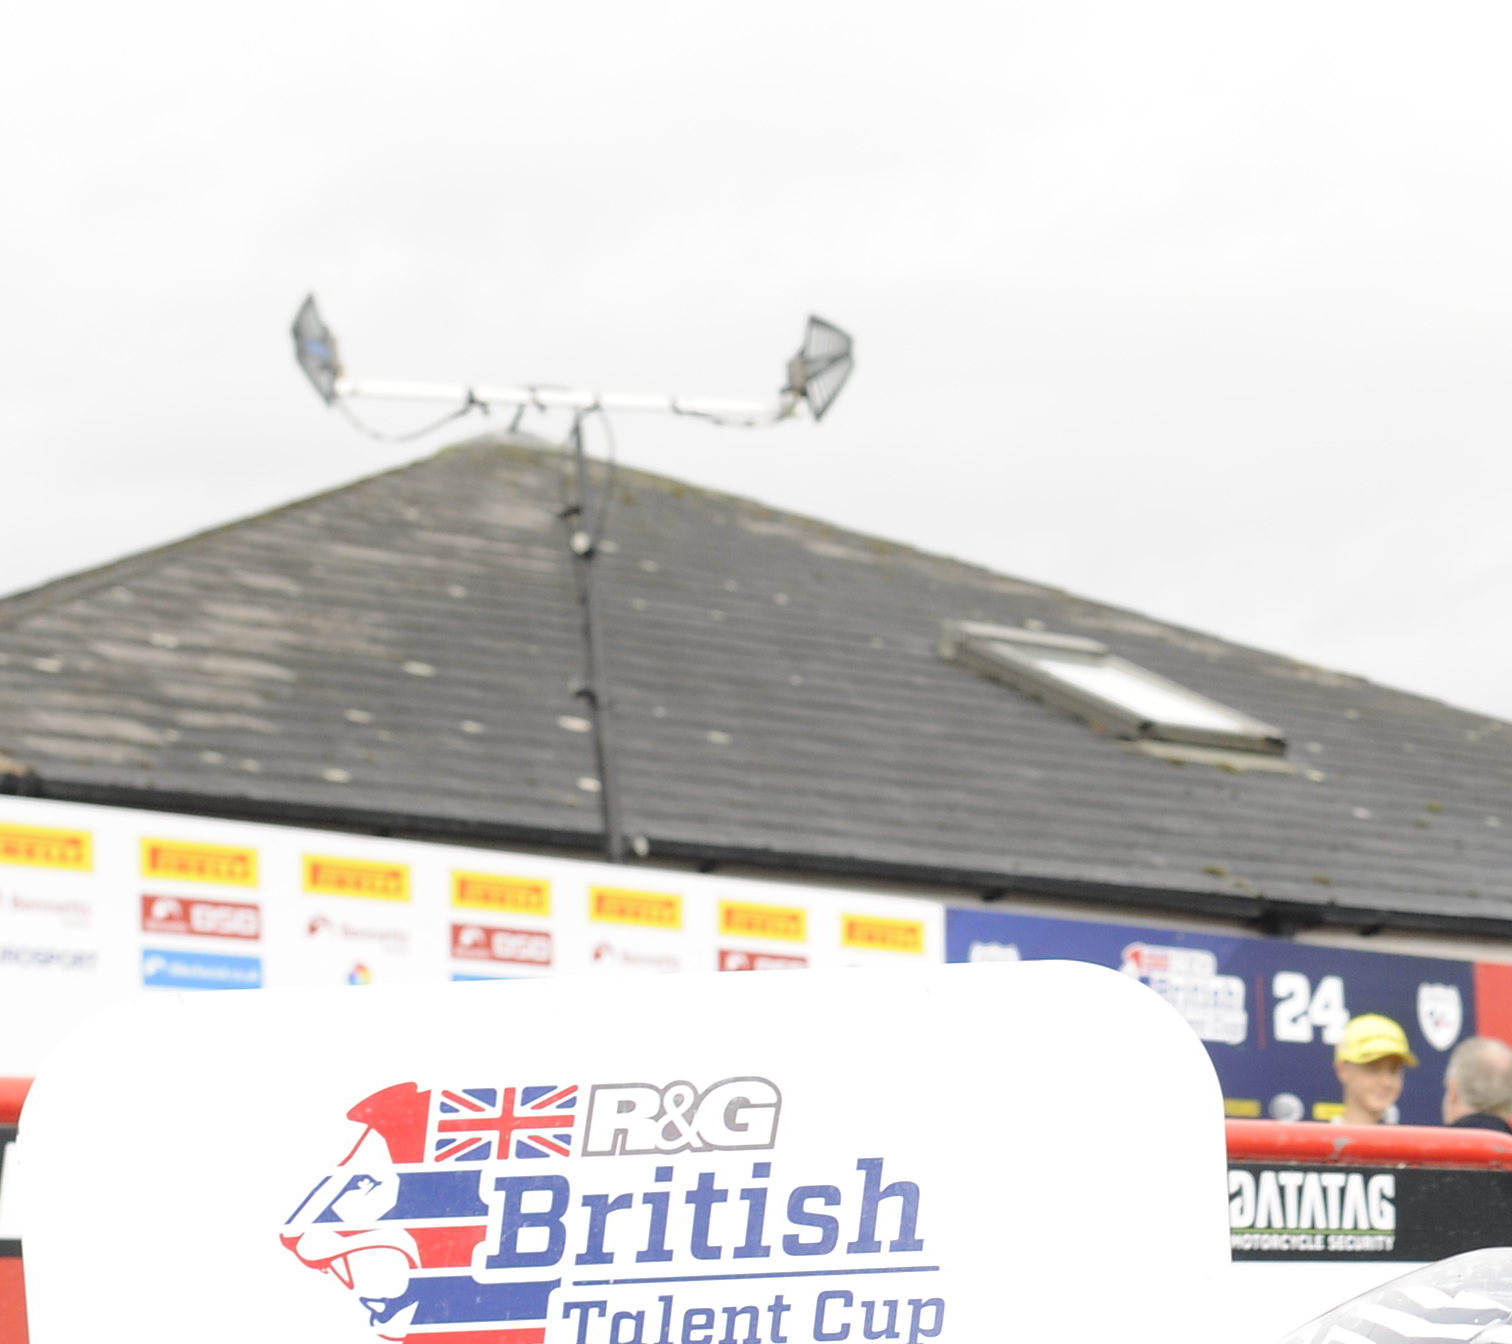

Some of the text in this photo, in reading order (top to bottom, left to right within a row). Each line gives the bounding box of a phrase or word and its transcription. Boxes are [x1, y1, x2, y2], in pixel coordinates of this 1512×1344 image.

[1272, 971, 1350, 1044] 24
[581, 1076, 782, 1157] R&G
[485, 1158, 924, 1270] British
[1229, 1171, 1395, 1230] DATATAG
[1328, 1234, 1395, 1252] SECURITY
